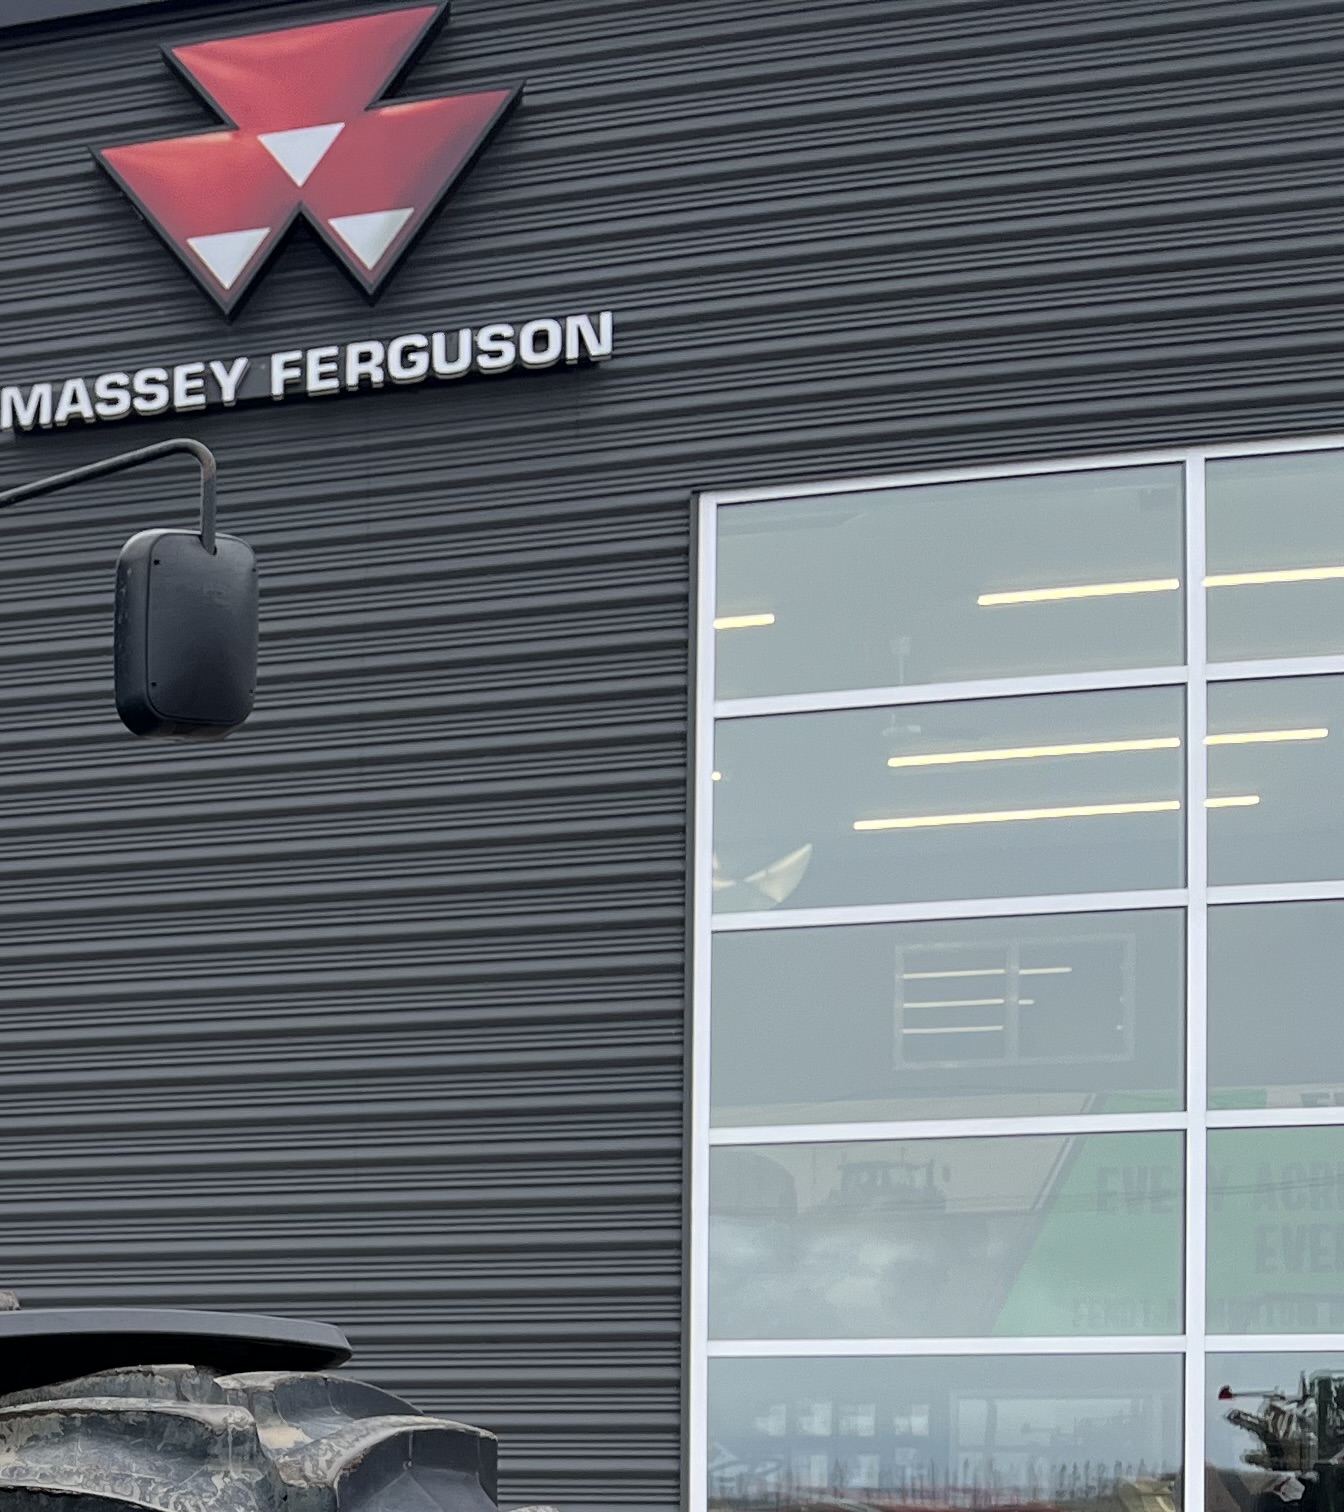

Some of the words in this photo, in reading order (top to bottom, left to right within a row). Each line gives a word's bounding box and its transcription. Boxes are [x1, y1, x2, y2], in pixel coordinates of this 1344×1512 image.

[0, 357, 250, 431] MASSEY
[269, 311, 613, 399] FERGUSON
[1096, 1162, 1233, 1215] EVEY
